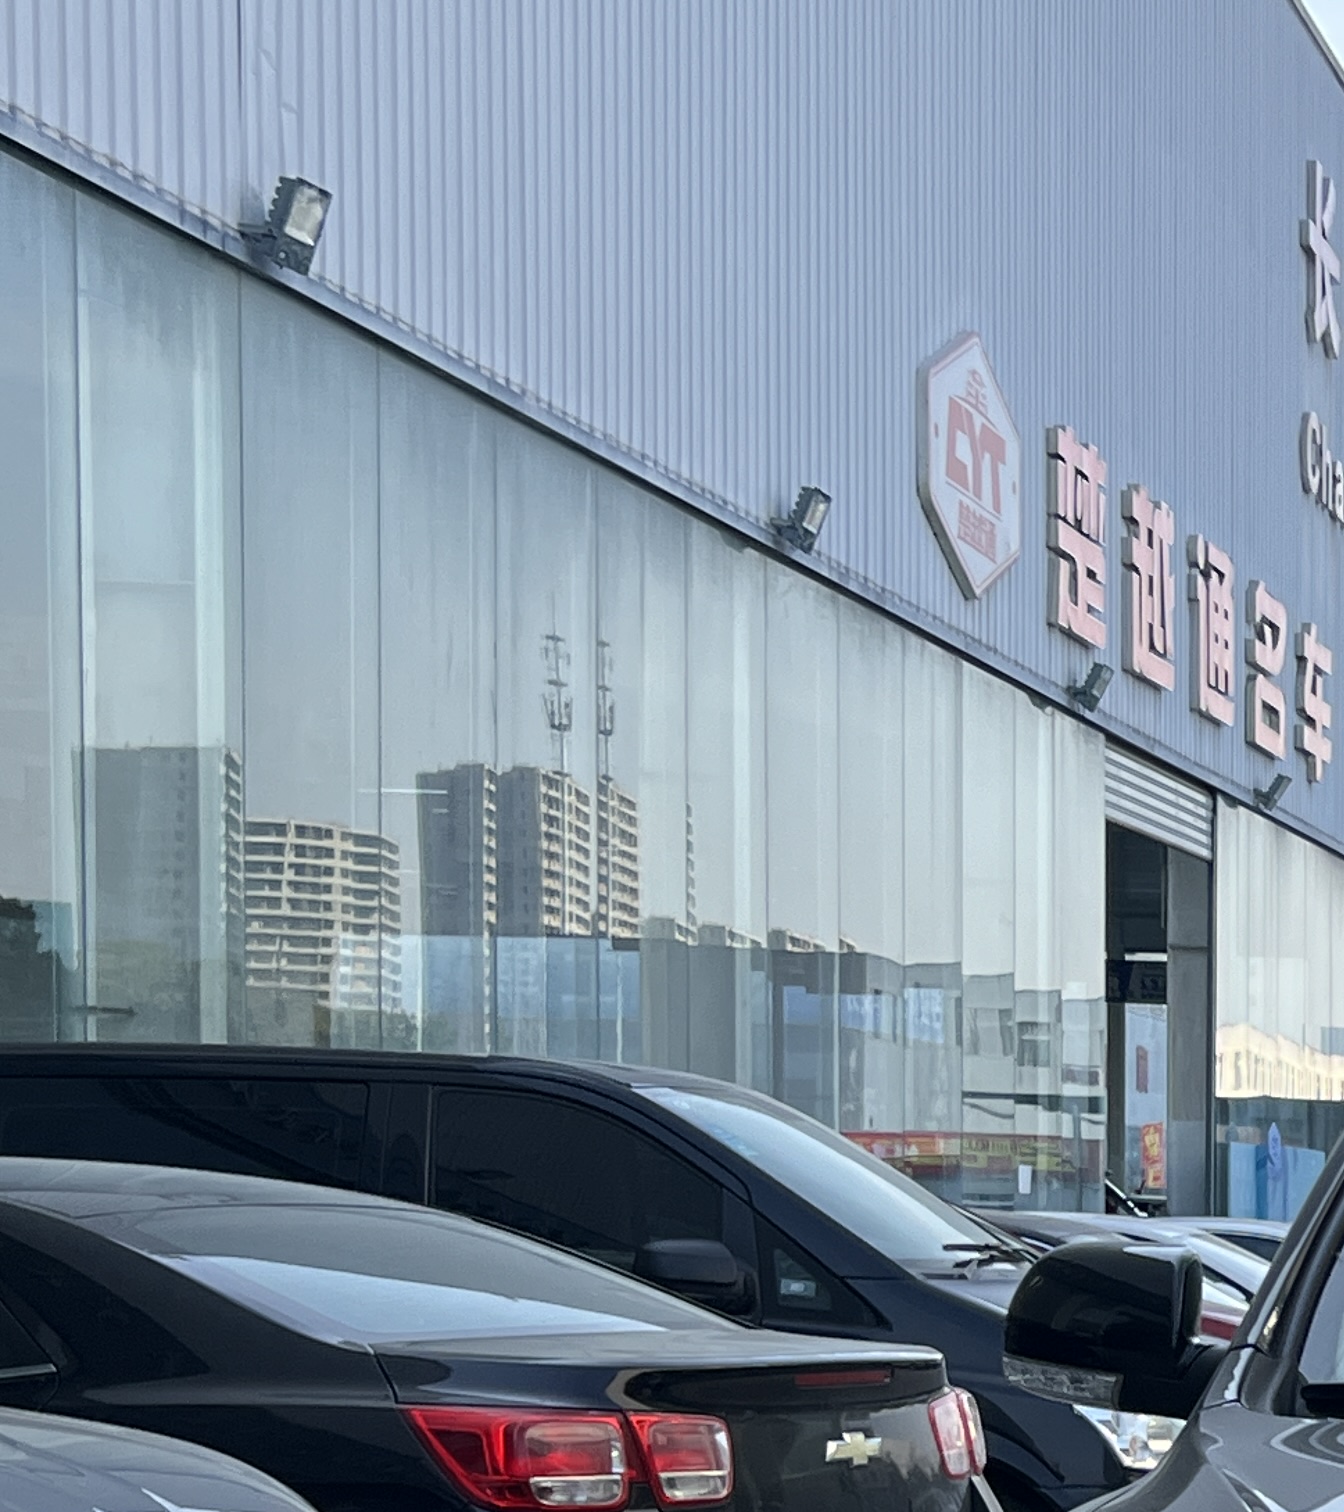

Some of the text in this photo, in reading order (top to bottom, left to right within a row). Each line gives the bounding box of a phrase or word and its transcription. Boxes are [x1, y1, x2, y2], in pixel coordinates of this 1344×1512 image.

[945, 395, 1007, 516] CYT
[1046, 424, 1333, 785] 楚越通名车
